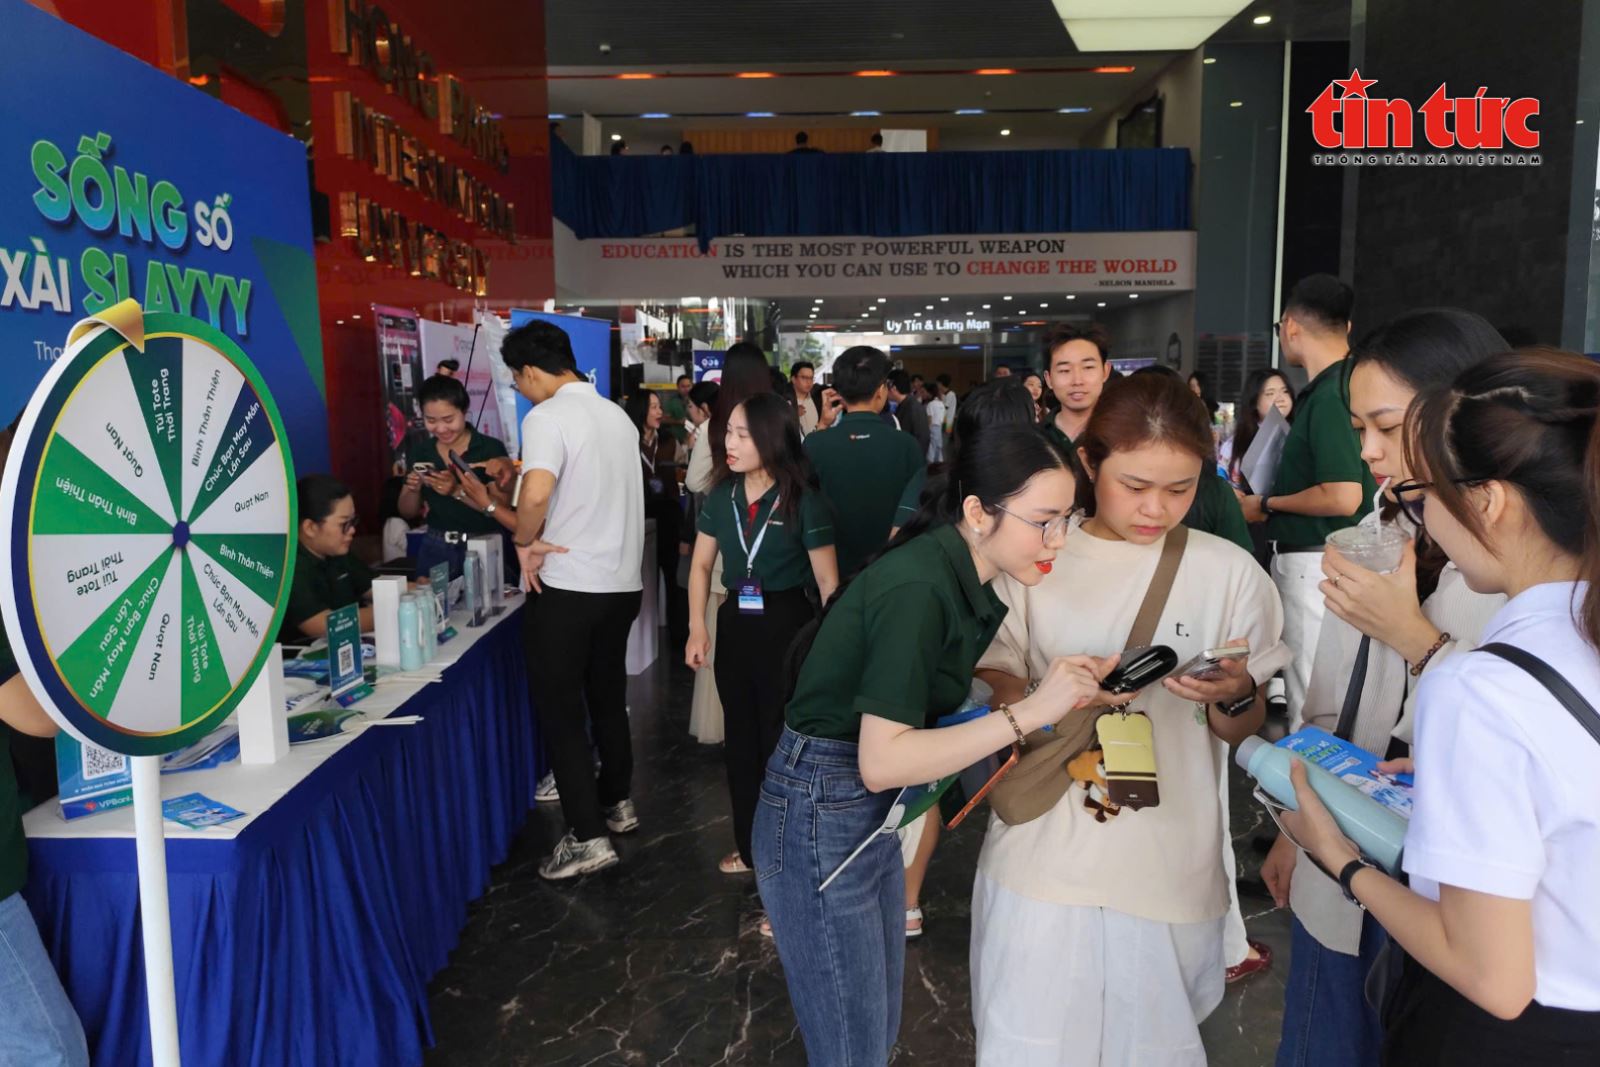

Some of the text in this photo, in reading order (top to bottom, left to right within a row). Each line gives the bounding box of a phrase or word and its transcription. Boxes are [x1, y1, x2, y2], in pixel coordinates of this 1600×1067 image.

[31, 131, 188, 249] SỐNG
[194, 193, 233, 251] SỐ
[724, 243, 745, 258] IS
[752, 242, 793, 257] THE
[800, 242, 856, 257] MOST
[862, 240, 973, 256] POWERFUL
[979, 239, 1064, 254] WEAPON
[0, 236, 72, 313] XÀI
[722, 258, 1177, 279] WHICH YOU CAN USE TO CHANGE THE WORLD
[886, 320, 902, 333] Uy
[924, 320, 933, 331] &
[935, 319, 964, 332] Lãng
[966, 319, 990, 331] Mạn
[160, 368, 172, 409] Trang
[207, 369, 221, 401] Thiện
[152, 379, 164, 434] Túi Tote
[105, 422, 143, 478] Quạt Nan
[204, 464, 223, 492] Chúc
[220, 444, 235, 467] Bạn
[232, 422, 248, 445] May
[238, 437, 253, 458] Sau
[55, 477, 86, 502] Thiện
[234, 491, 270, 513] Quạt Nan
[67, 562, 100, 583] Trang
[76, 570, 119, 596] Túi Tote
[256, 561, 275, 580] Thiện
[139, 577, 159, 610] Chúc
[203, 562, 221, 589] Chúc
[220, 584, 234, 605] Bạn
[233, 600, 247, 623] May
[123, 609, 142, 636] Bạn
[225, 612, 239, 634] Sau
[99, 624, 118, 652] Sau
[107, 637, 127, 667] May
[148, 613, 170, 681] Quạt Nan
[191, 644, 202, 683] Trang
[200, 640, 209, 670] Tote
